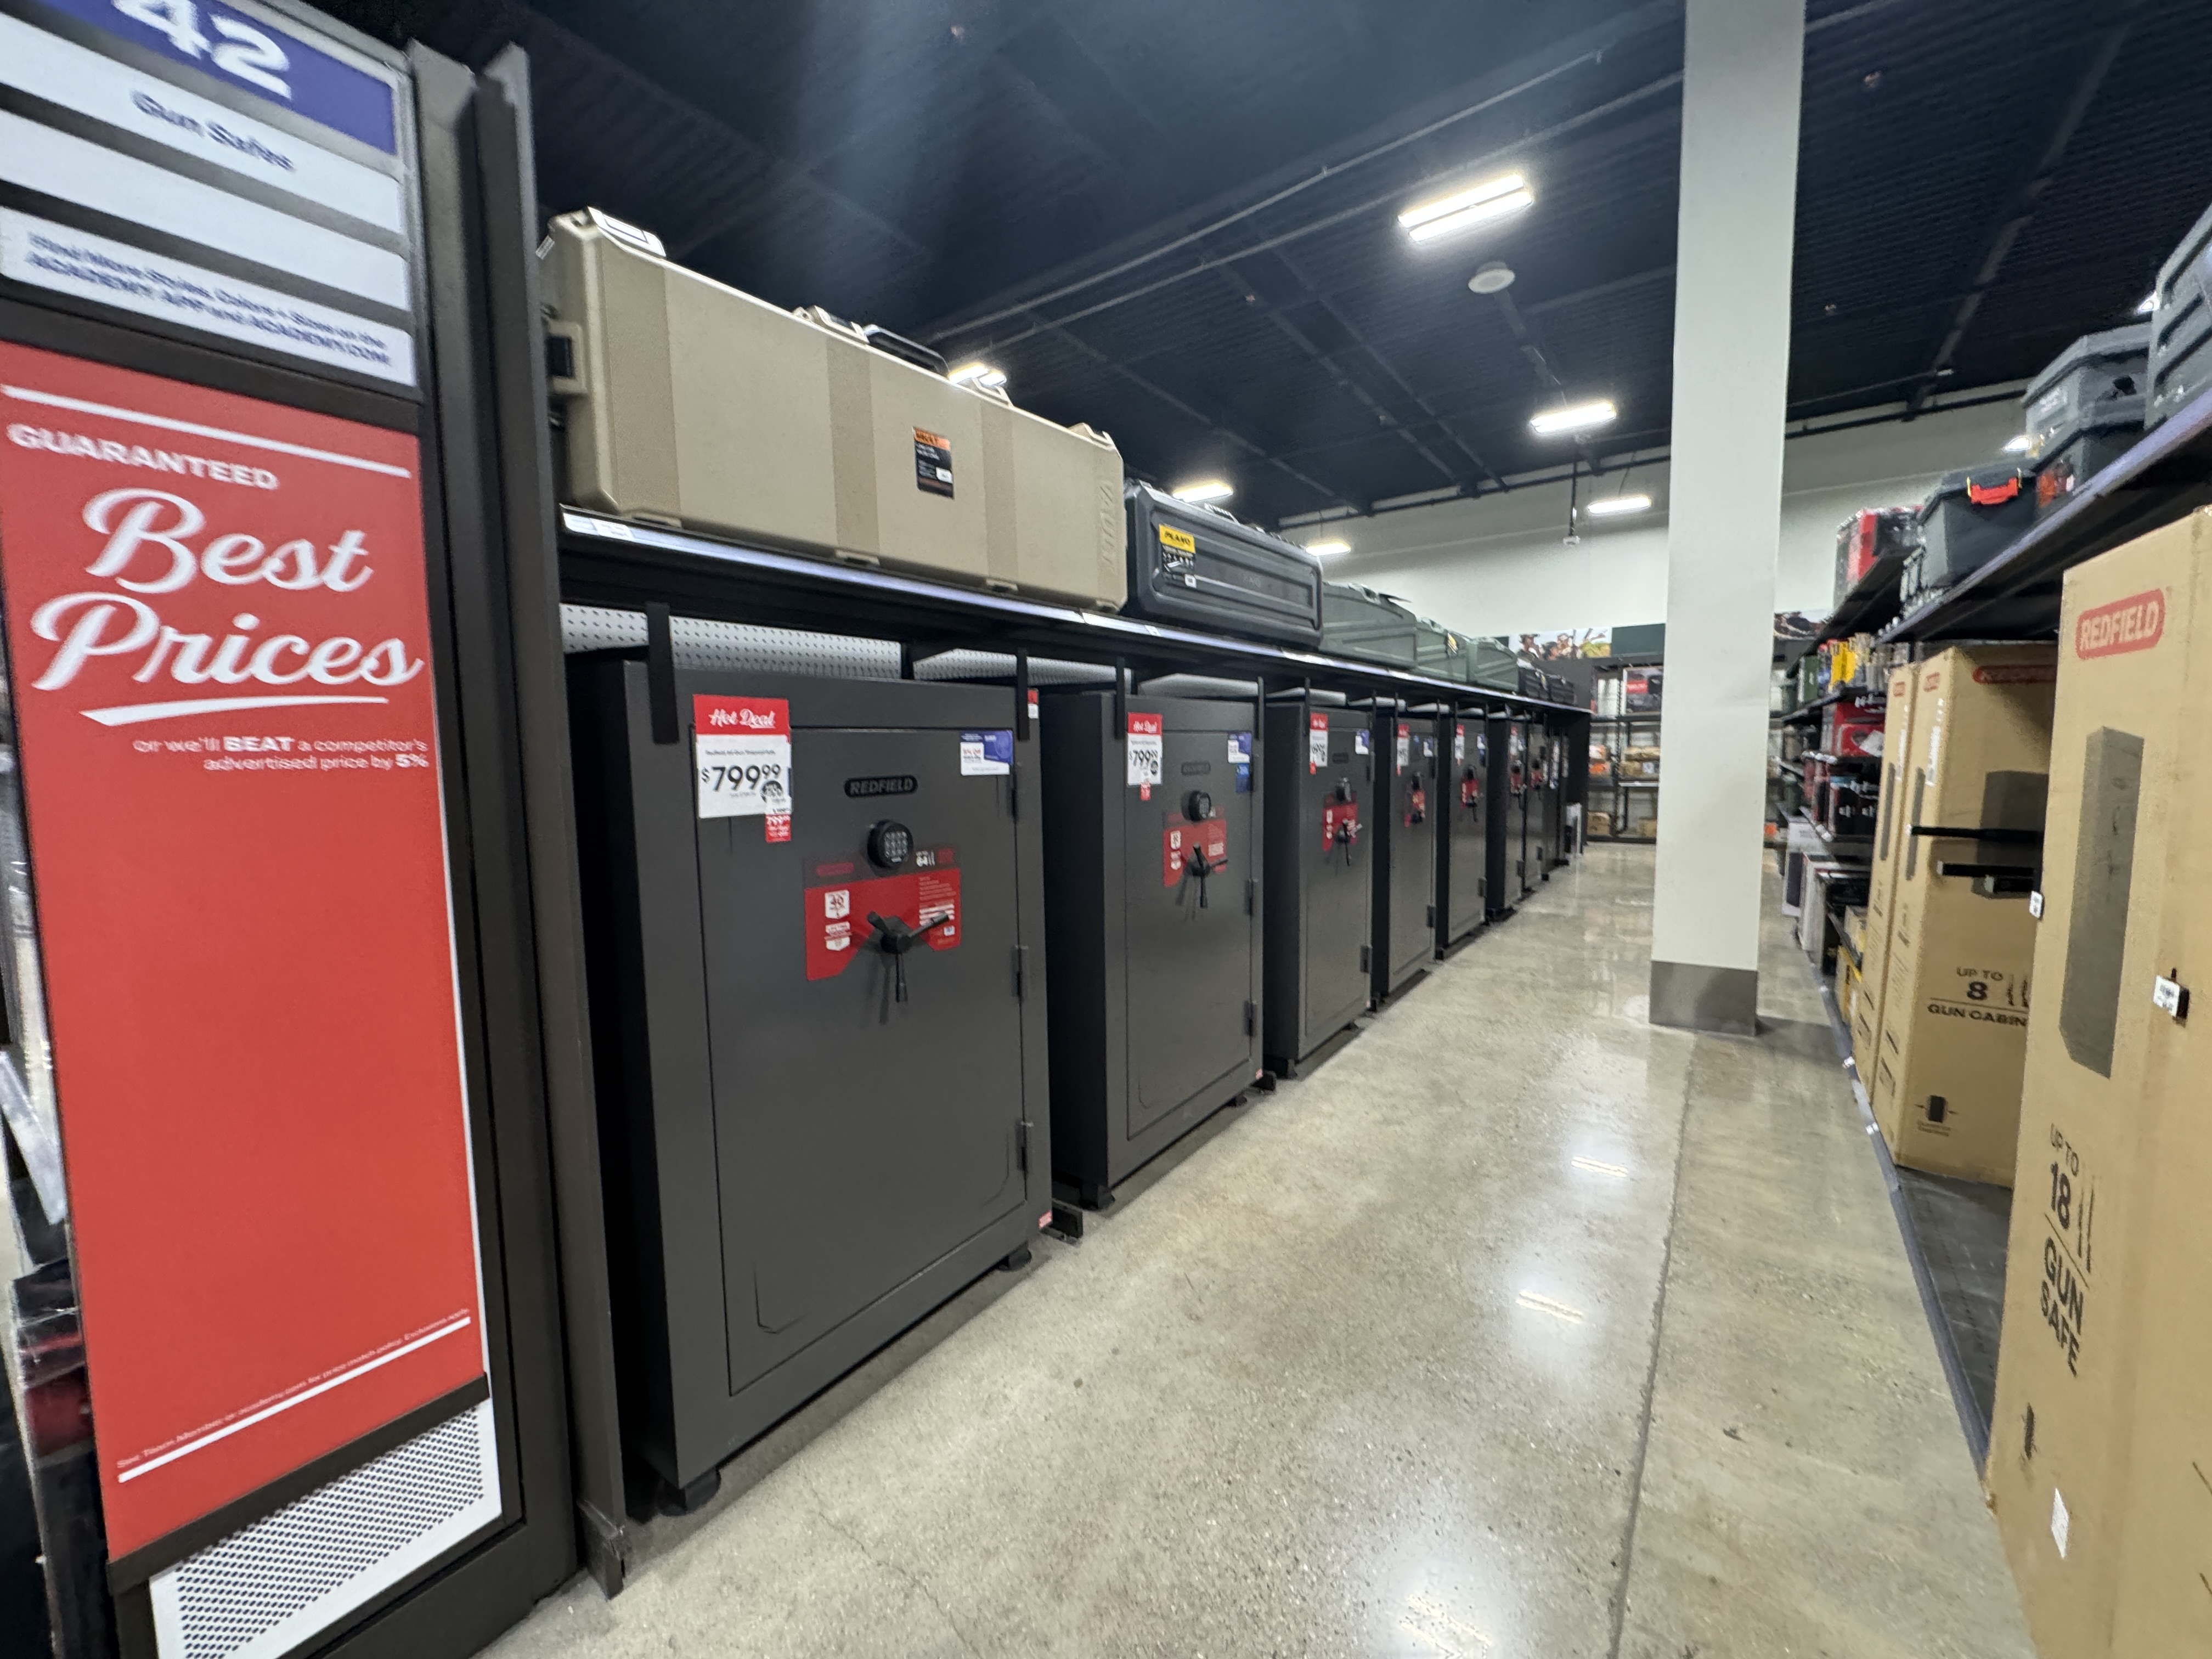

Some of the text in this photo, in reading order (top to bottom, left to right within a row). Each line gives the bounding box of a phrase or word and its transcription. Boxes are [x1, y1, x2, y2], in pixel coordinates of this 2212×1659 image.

[112, 0, 292, 99] 42
[131, 89, 205, 137] Gun
[7, 423, 280, 490] GUARANTEED
[82, 487, 375, 594] Best
[30, 591, 425, 691] Prices
[2079, 600, 2160, 651] REDFIELD
[708, 708, 776, 729] Hot Deal
[132, 736, 428, 753] or we'll BEAT a competitor's
[204, 753, 429, 771] advertised price by 5%
[850, 777, 913, 795] REDFIELD
[1956, 967, 2004, 981] UP TO
[1967, 981, 1989, 1001] 8
[1927, 1004, 2029, 1027] GUN CABIN
[2051, 1160, 2071, 1231] 18
[2045, 1236, 2084, 1335] GUN
[2040, 1279, 2080, 1378] SAFE
